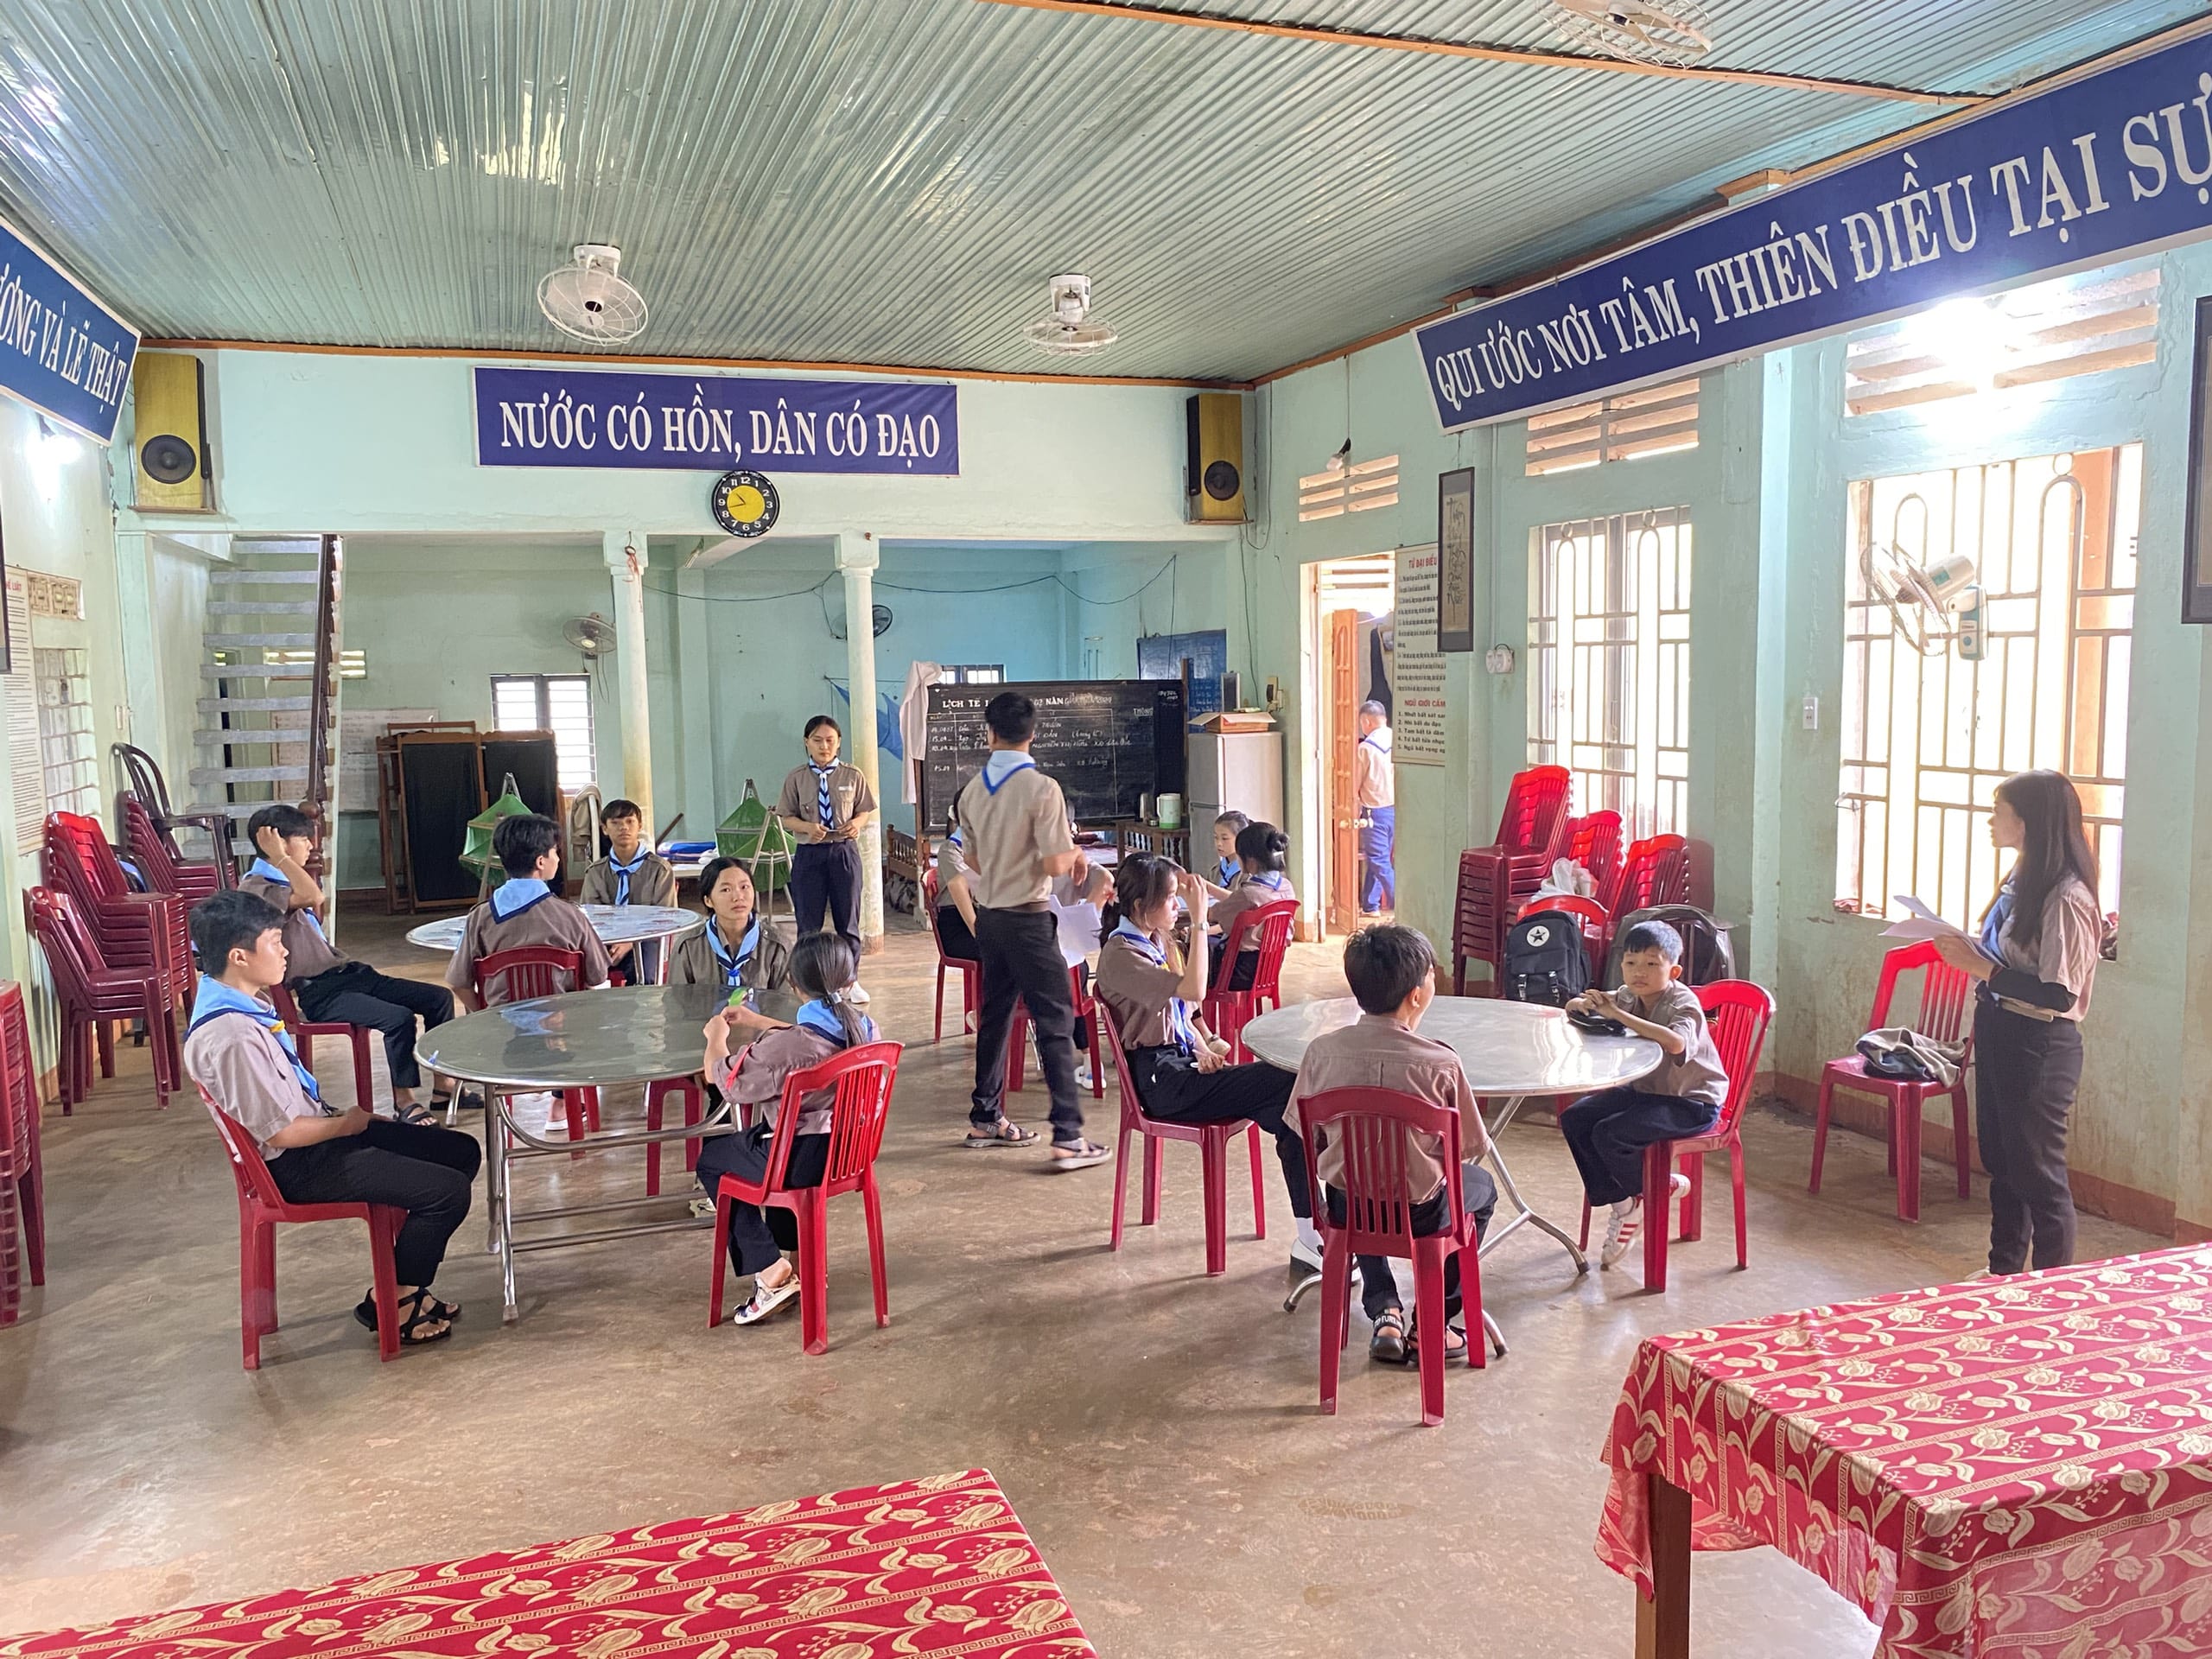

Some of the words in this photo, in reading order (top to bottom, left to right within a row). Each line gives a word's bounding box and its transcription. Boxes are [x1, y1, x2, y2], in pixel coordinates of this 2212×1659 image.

[1435, 345, 1484, 411] QUI
[1478, 320, 1542, 390] ƯỚC
[1537, 304, 1606, 373] NƠI
[1600, 276, 1700, 344] TÂM,
[1695, 221, 1838, 324] THIÊN
[1841, 152, 1977, 283] ĐIỀU
[1990, 132, 2109, 243] TẠI
[2123, 72, 2212, 204] SỰ
[0, 263, 41, 357] ƠNG
[39, 300, 65, 372] VÀ
[60, 320, 89, 385] LẼ
[84, 341, 126, 413] THẬT
[499, 388, 597, 450] NƯỚC
[607, 391, 652, 452] CÓ
[663, 382, 742, 462] HỒN,
[750, 397, 817, 455] DÂN
[825, 399, 868, 457] CÓ
[877, 413, 940, 467] ĐẠO
